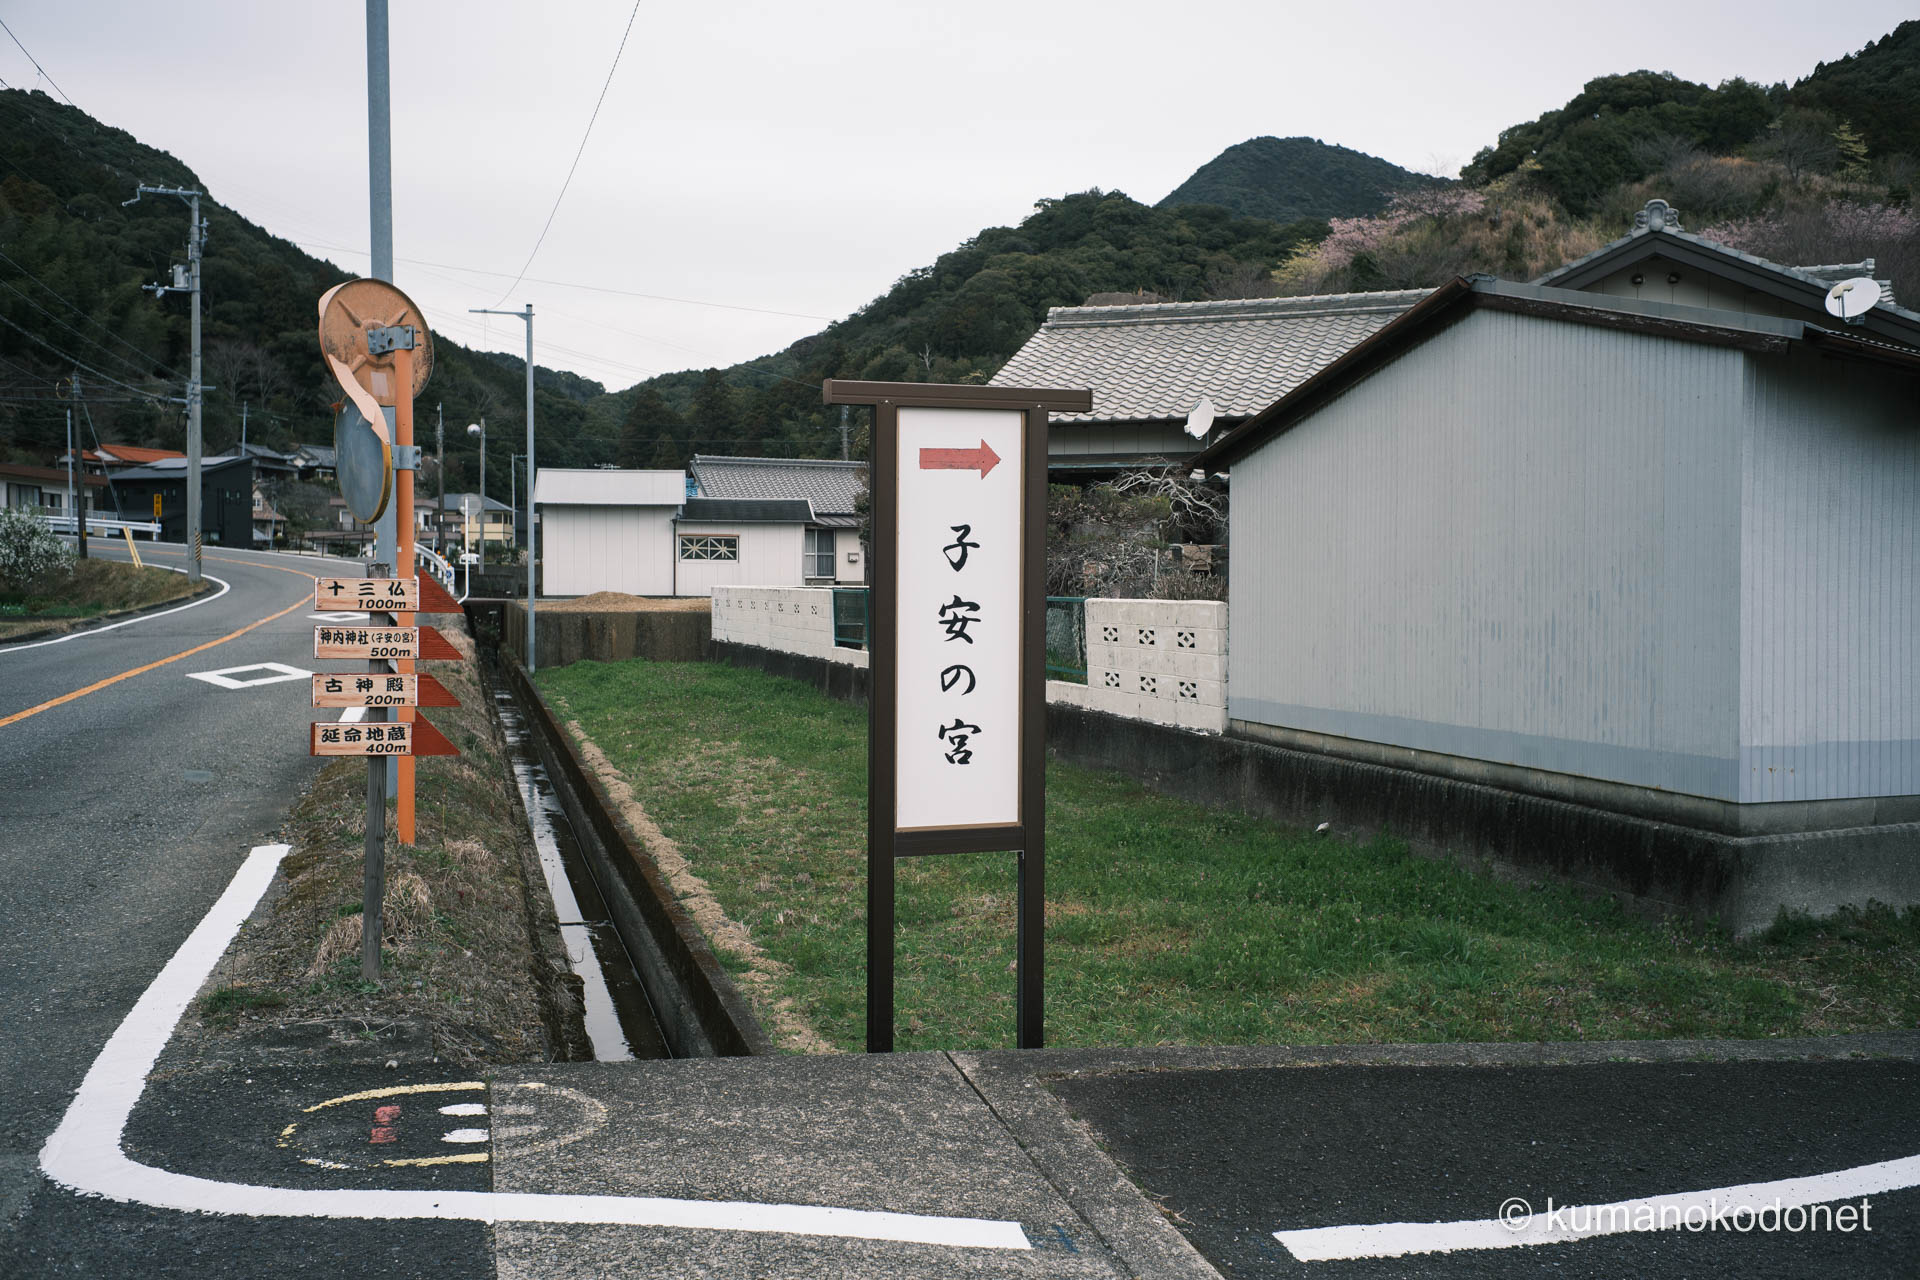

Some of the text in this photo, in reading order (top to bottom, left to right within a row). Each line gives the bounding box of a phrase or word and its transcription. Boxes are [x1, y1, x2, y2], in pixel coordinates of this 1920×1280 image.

[327, 581, 405, 596] 十三仏
[358, 599, 407, 609] 1000m
[938, 523, 982, 765] 子安の宮
[370, 647, 410, 657] 500m
[325, 677, 404, 693] 古神殿
[364, 695, 405, 705] 200m
[321, 727, 406, 743] 延命地蔵
[366, 743, 407, 753] 400m
